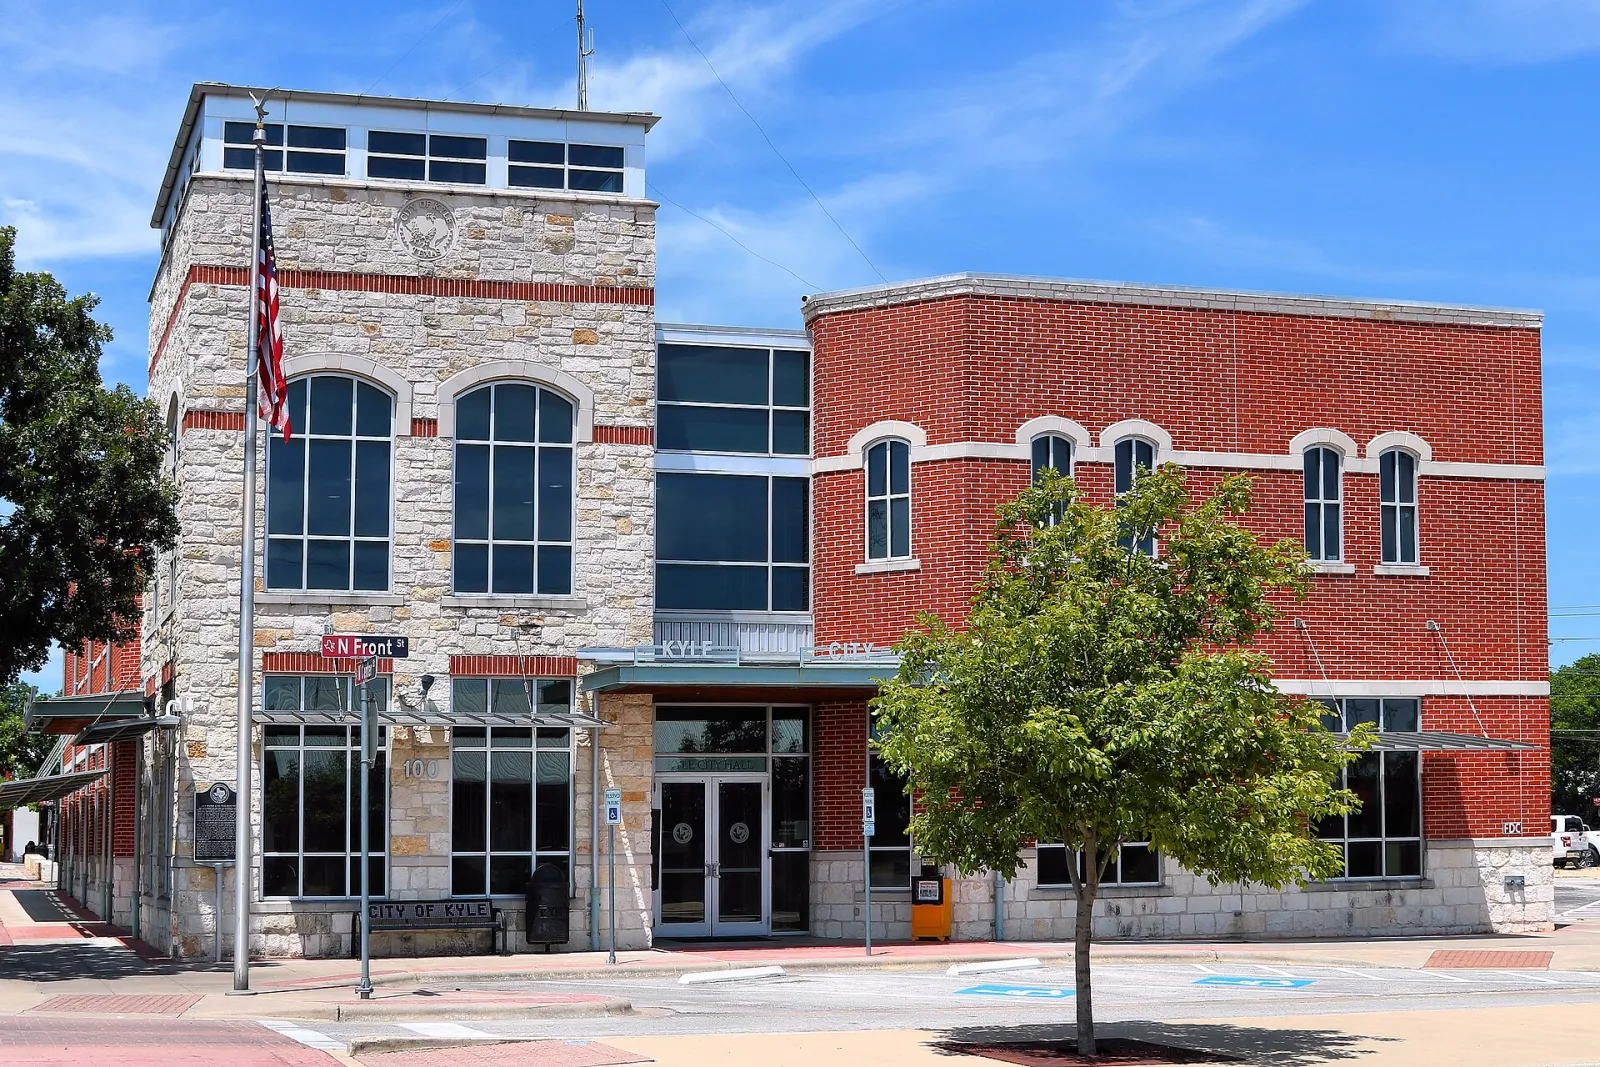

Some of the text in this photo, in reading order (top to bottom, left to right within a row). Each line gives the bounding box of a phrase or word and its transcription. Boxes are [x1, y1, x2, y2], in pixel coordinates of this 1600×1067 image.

[338, 638, 405, 655] N Front St
[662, 640, 875, 660] KYLE CITY
[403, 759, 440, 779] 100
[697, 760, 722, 770] CITY
[724, 760, 754, 770] HALL
[1503, 822, 1522, 834] FDC
[368, 903, 487, 919] CITY OF KYLE
